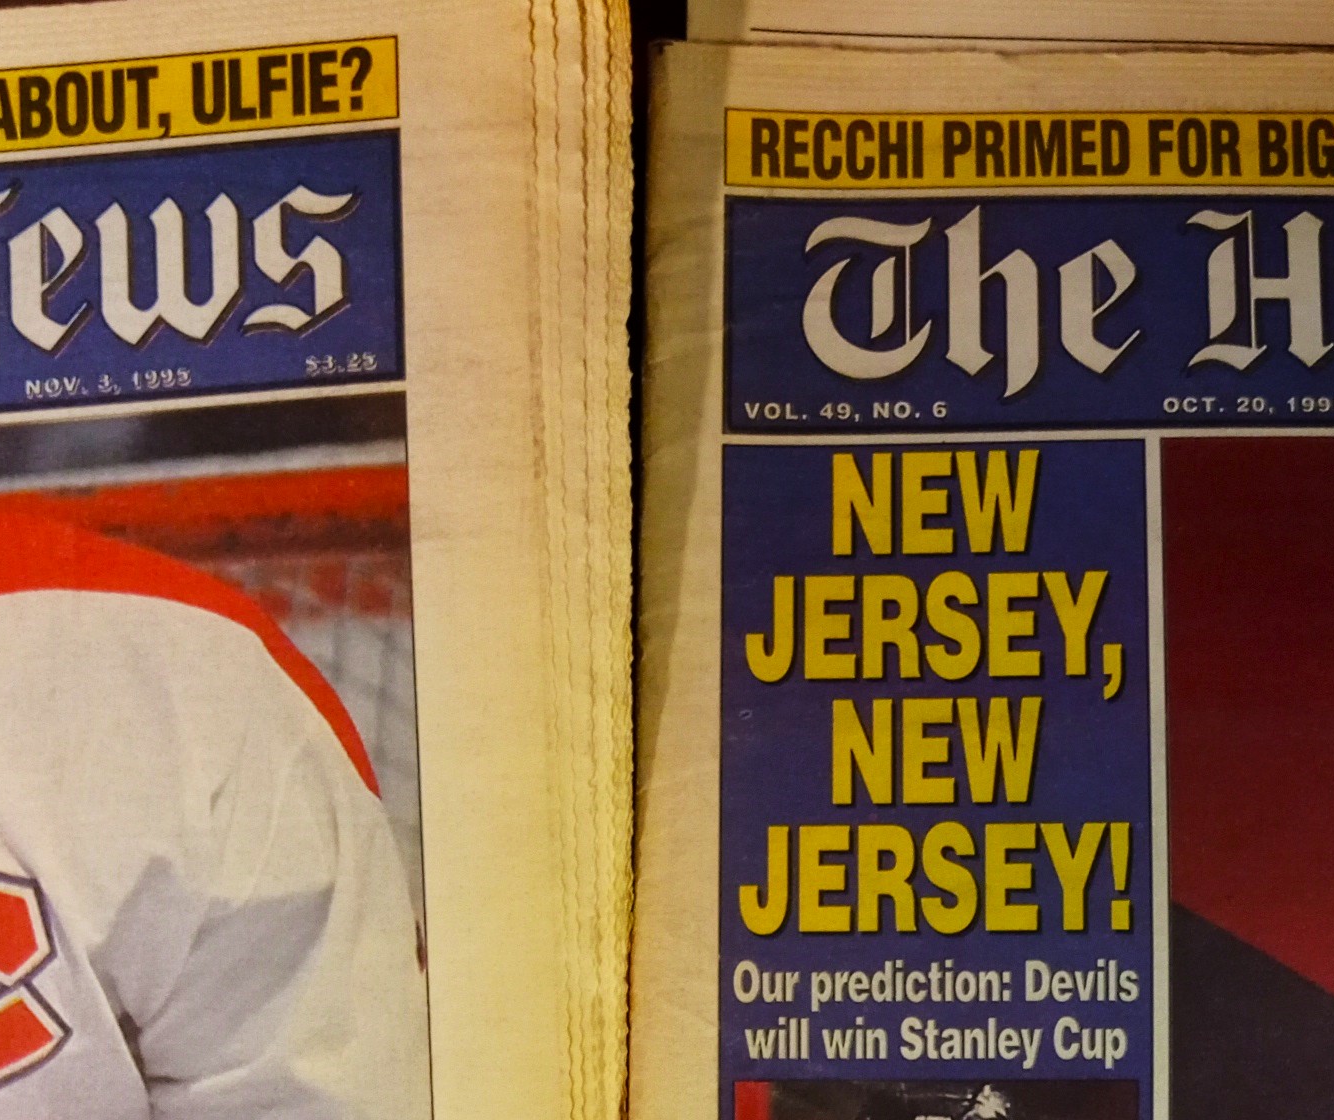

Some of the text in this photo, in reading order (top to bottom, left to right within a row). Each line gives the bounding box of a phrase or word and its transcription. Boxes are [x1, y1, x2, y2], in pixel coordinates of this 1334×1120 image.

[191, 46, 373, 126] ULFIE?
[750, 117, 925, 180] RECCHI
[942, 117, 1131, 179] PRIMED
[1148, 118, 1246, 178] FOR
[801, 204, 1143, 400] The
[24, 377, 90, 400] NOV.
[132, 366, 194, 392] 1995
[744, 401, 948, 423] VOL. 49, NO. 6
[1161, 396, 1226, 415] OCT.
[1235, 396, 1276, 416] 20,
[830, 448, 1041, 558] NEW
[744, 569, 1126, 701] JERSEY,
[831, 696, 1043, 806] NEW
[738, 821, 1131, 936] JERSEY!
[733, 958, 1140, 1013] Our prediction: Devils
[745, 1016, 1128, 1069] will win Stanley Cup
